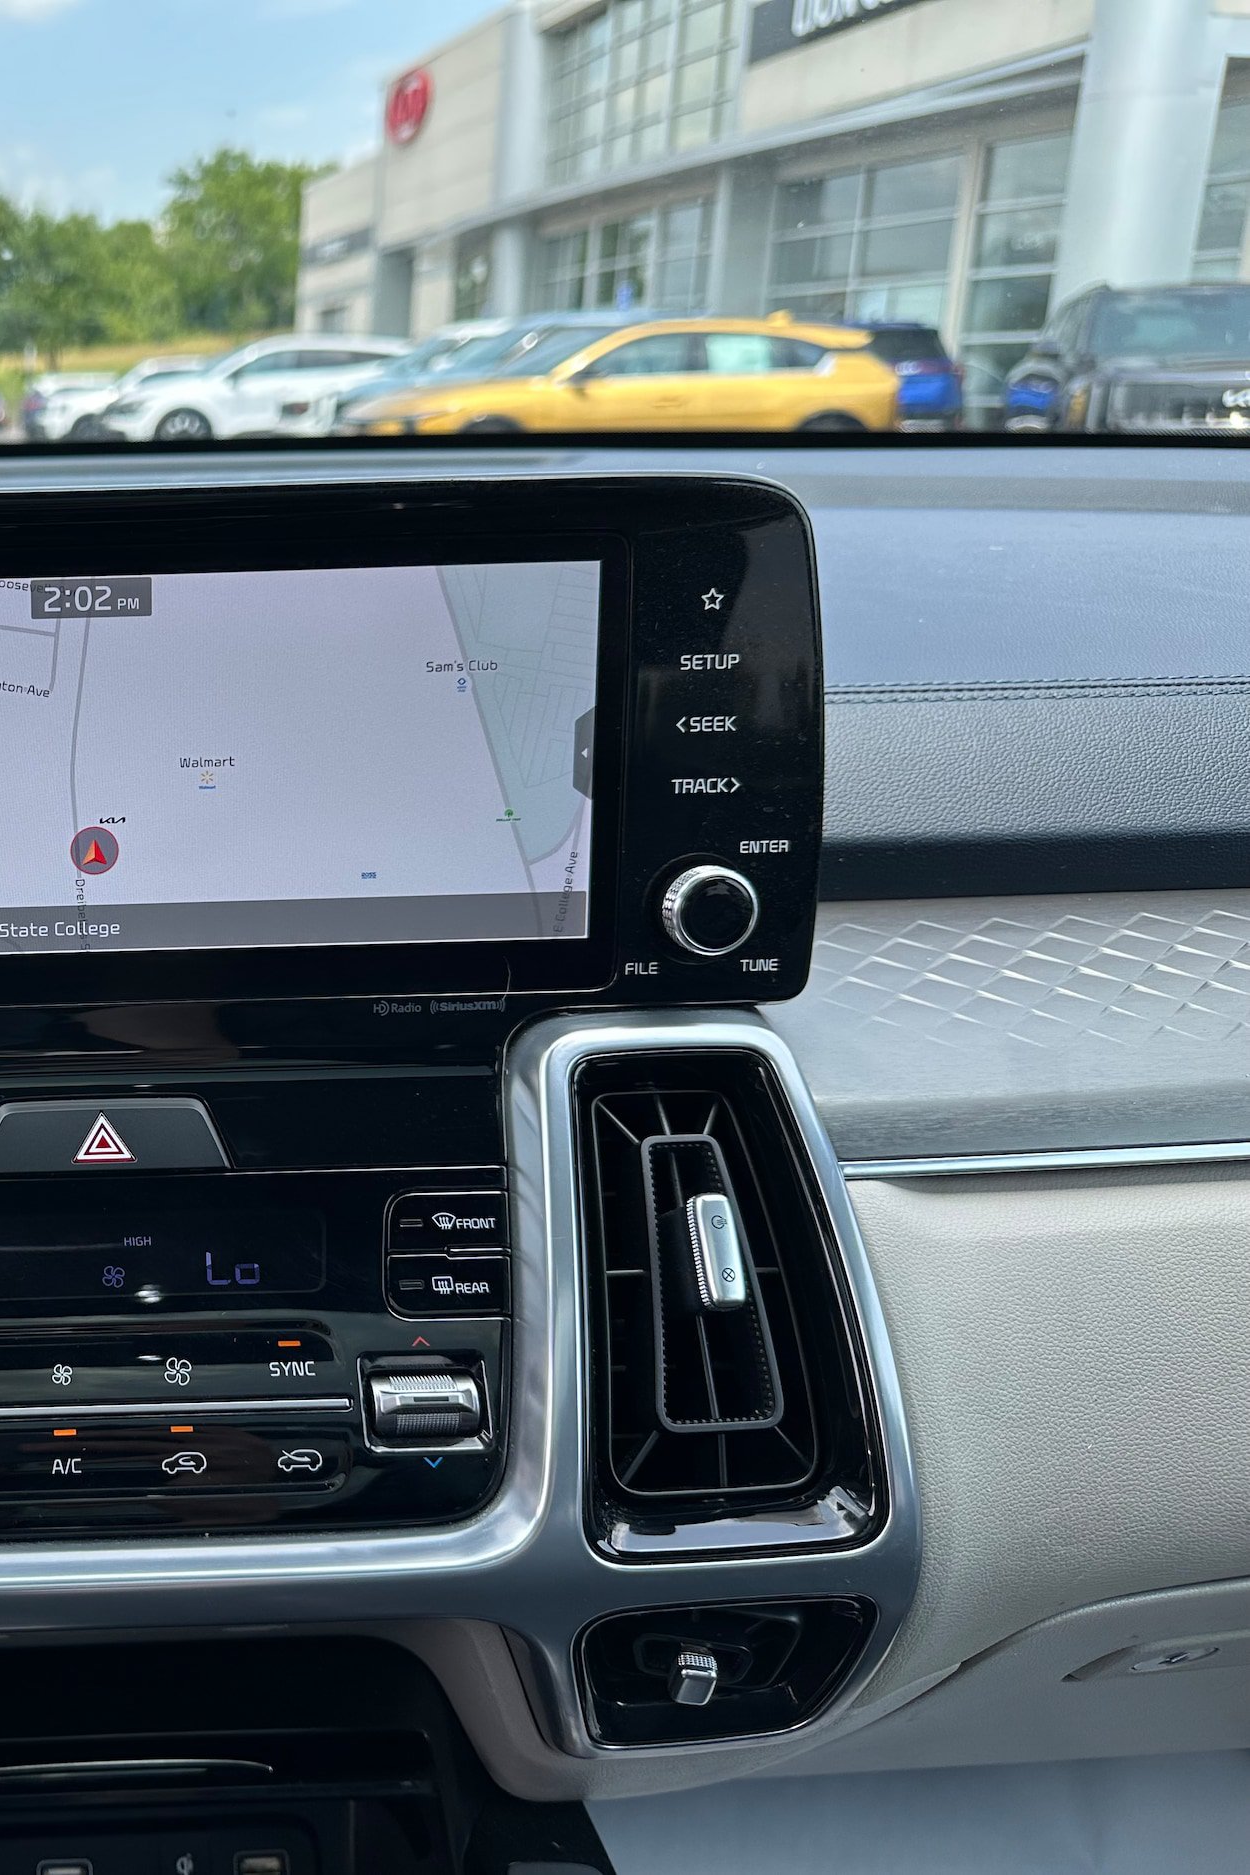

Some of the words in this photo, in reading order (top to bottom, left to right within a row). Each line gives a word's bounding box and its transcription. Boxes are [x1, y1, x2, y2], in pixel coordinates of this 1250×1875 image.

[43, 585, 112, 612] 2:02
[117, 597, 140, 610] PM
[426, 660, 465, 673] Sam's
[468, 659, 499, 672] Club
[680, 653, 740, 671] SETUP
[26, 684, 50, 698] Ave
[689, 715, 738, 732] SEEK
[179, 756, 236, 768] Walmart
[671, 778, 729, 795] TRACK
[739, 839, 790, 854] ENTER
[564, 851, 579, 875] Ave
[54, 920, 121, 938] College
[625, 961, 660, 976] FILE
[740, 958, 779, 973] TUNE
[391, 1002, 422, 1014] Radio
[455, 1217, 496, 1230] FRONT
[123, 1236, 152, 1247] HIGH
[205, 1251, 261, 1286] Lo
[455, 1281, 490, 1295] REAR
[269, 1360, 316, 1377] SYNC
[51, 1457, 82, 1475] A/C
